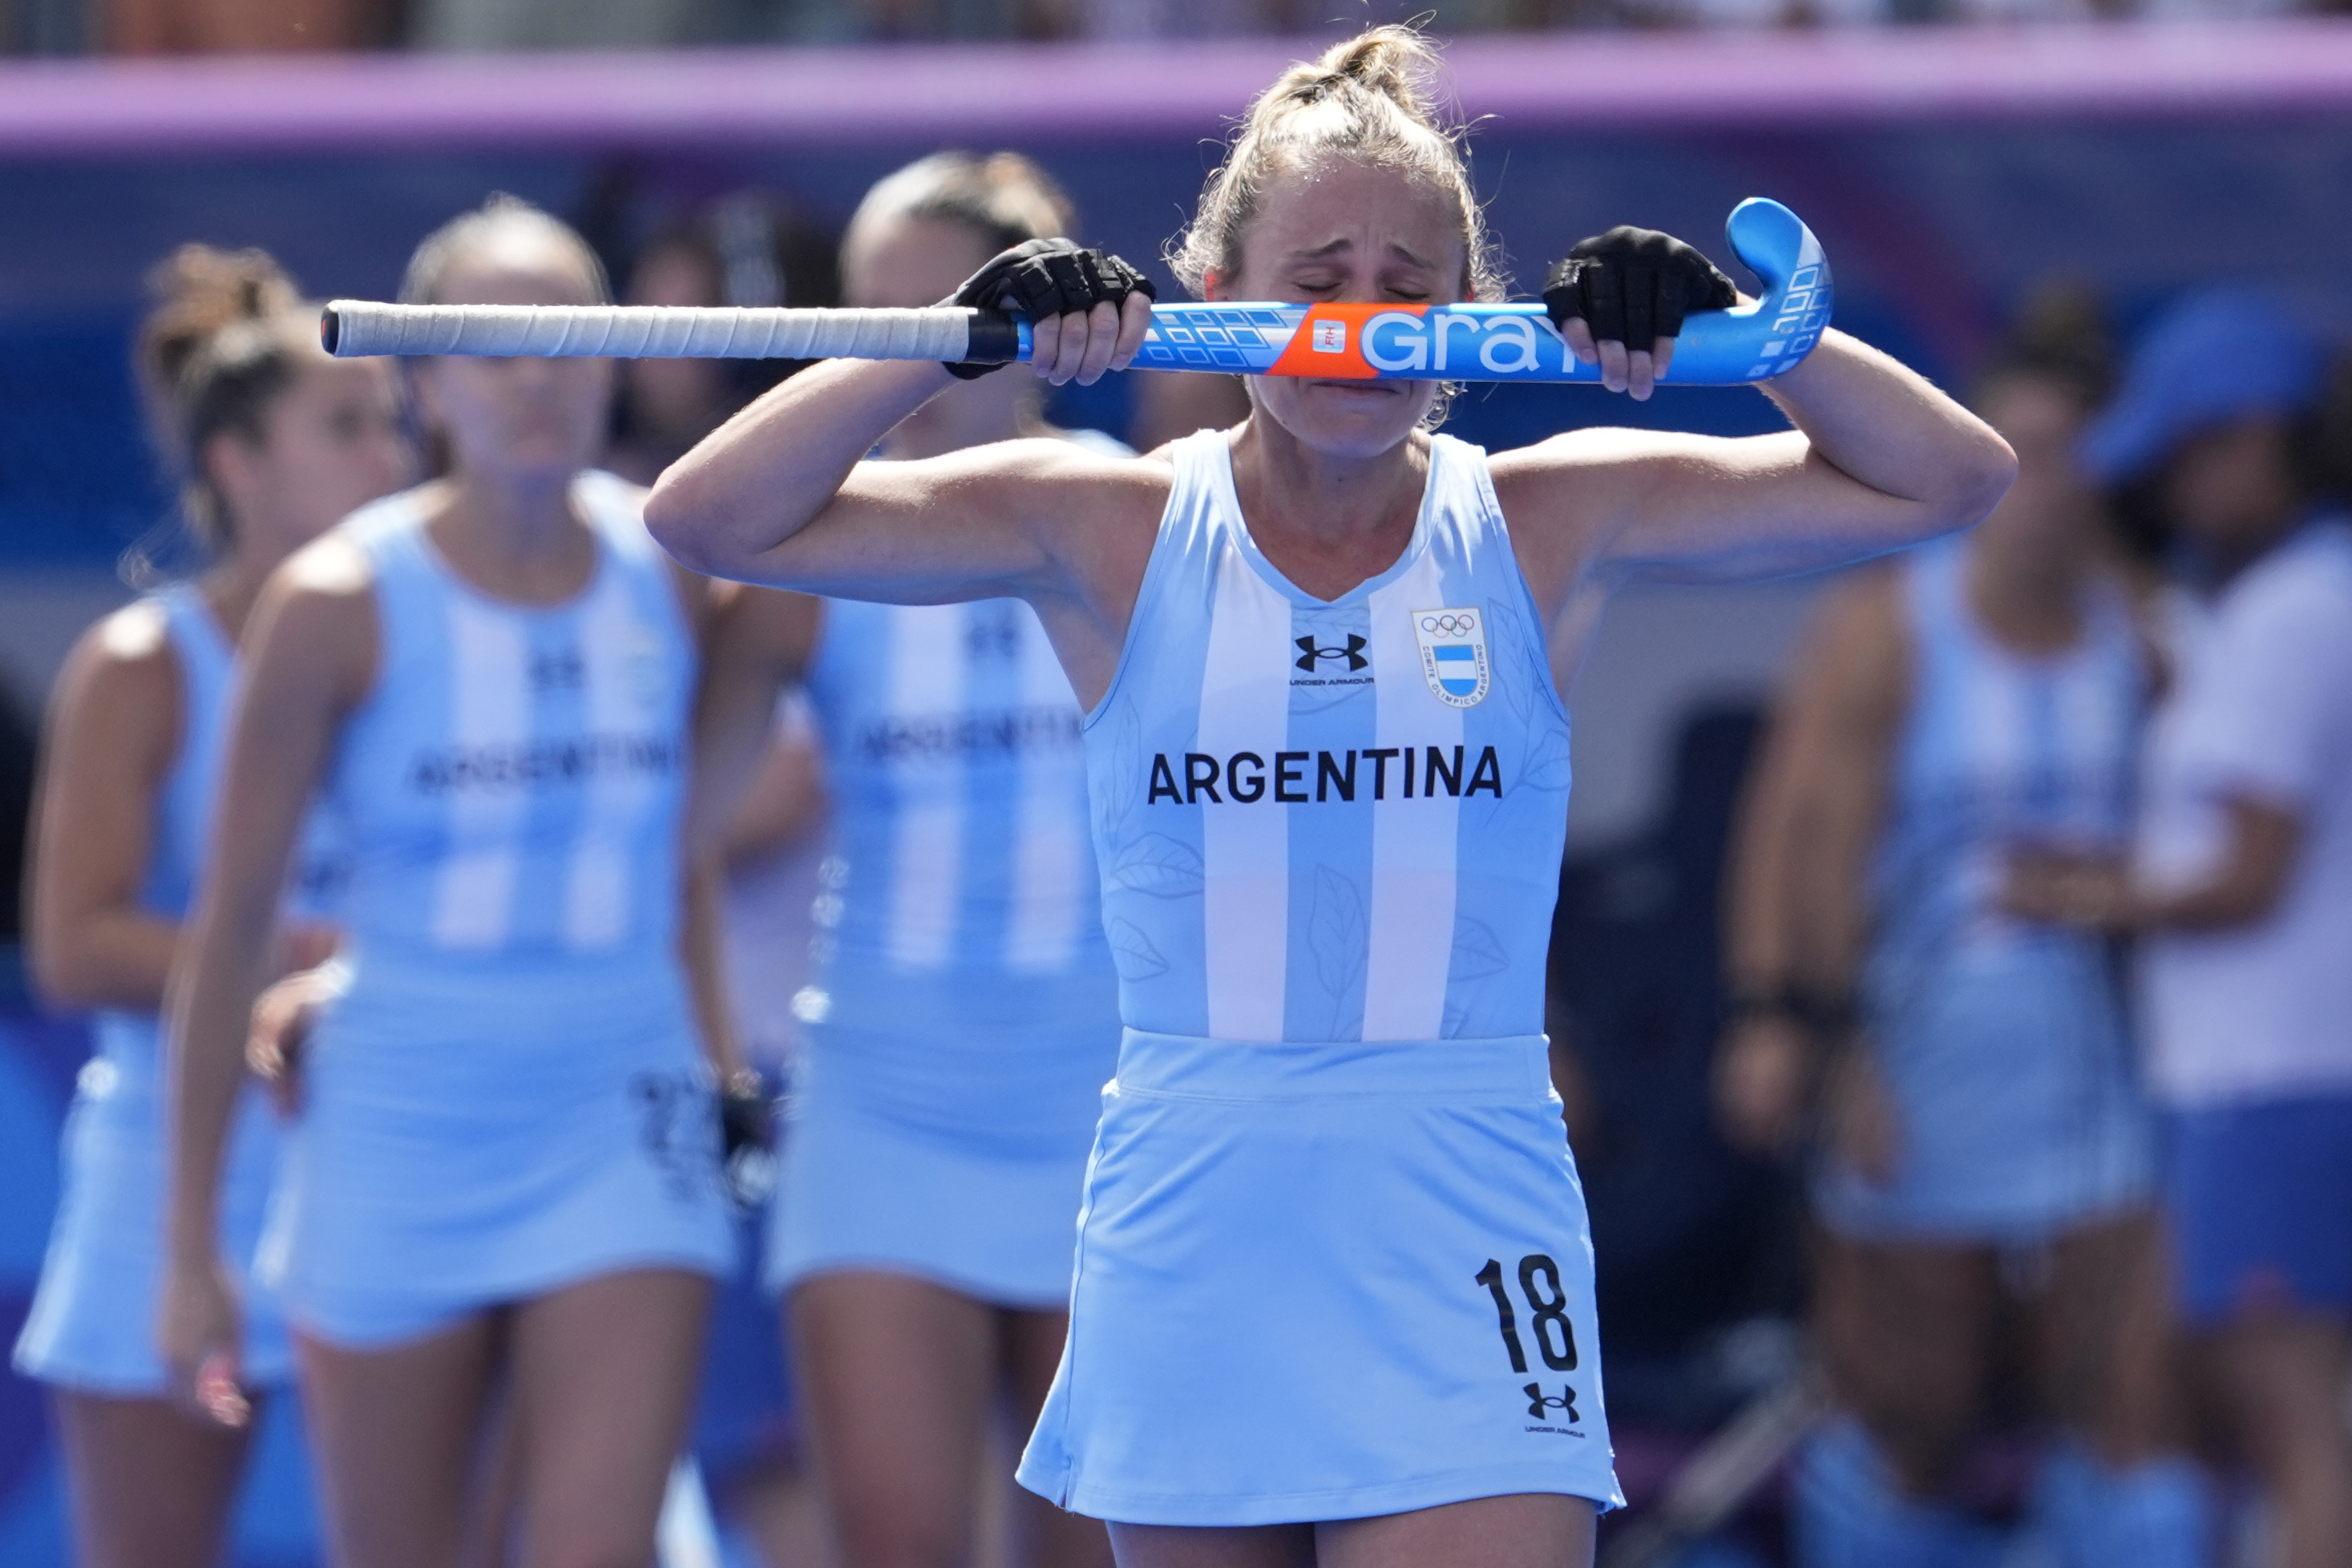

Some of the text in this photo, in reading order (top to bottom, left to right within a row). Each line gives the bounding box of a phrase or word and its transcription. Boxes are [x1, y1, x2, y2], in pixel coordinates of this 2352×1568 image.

[1328, 677, 1375, 686] ARMOUR
[1147, 745, 1504, 805] ARGENTINA
[1475, 1254, 1578, 1373] 18
[1557, 1427, 1586, 1439] ARMOUR
